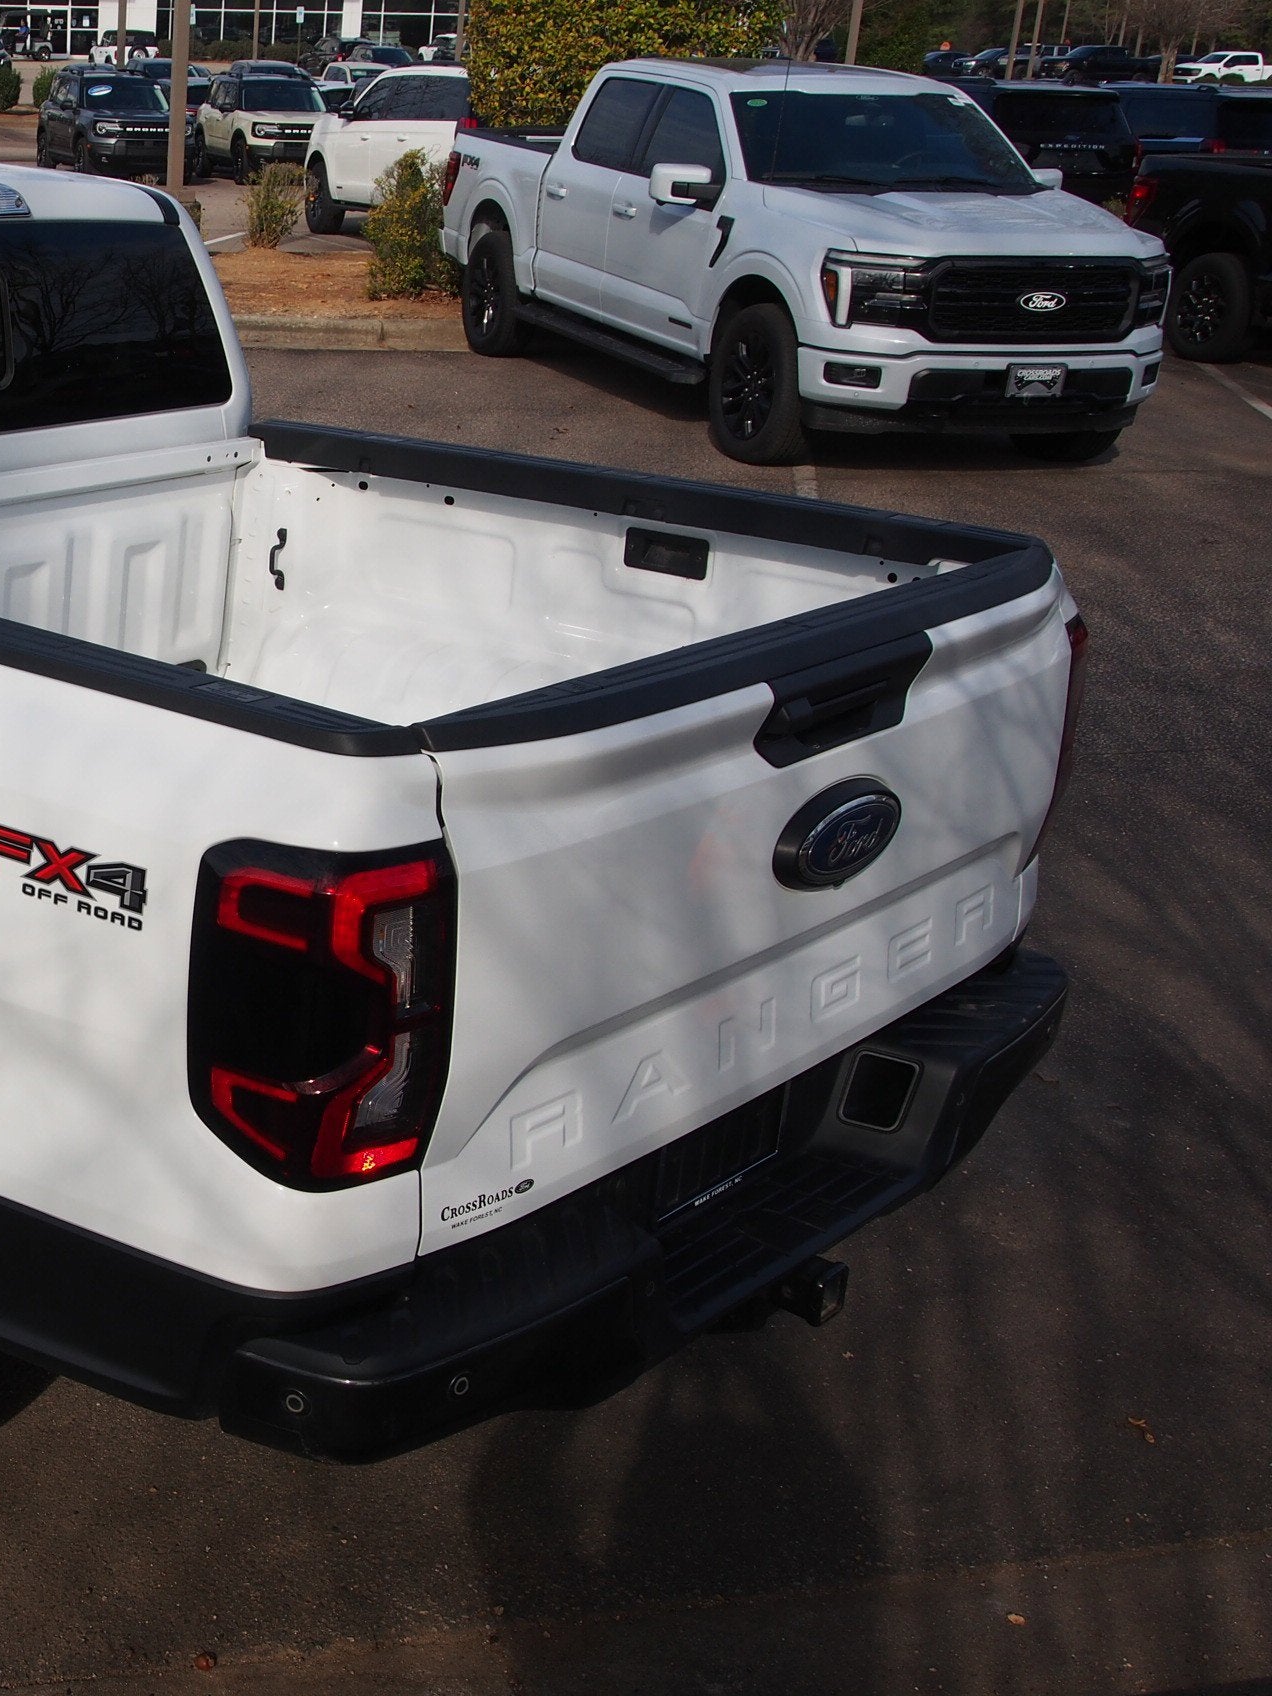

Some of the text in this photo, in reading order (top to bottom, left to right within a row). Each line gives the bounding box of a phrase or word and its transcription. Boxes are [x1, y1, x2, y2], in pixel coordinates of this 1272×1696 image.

[827, 813, 884, 865] Ford
[21, 882, 143, 932] OFF ROAD
[509, 885, 995, 1173] RANGER
[694, 1193, 711, 1207] WAKE
[734, 1175, 743, 1184] NC
[451, 1218, 468, 1230] WAKE
[494, 1206, 503, 1214] NC
